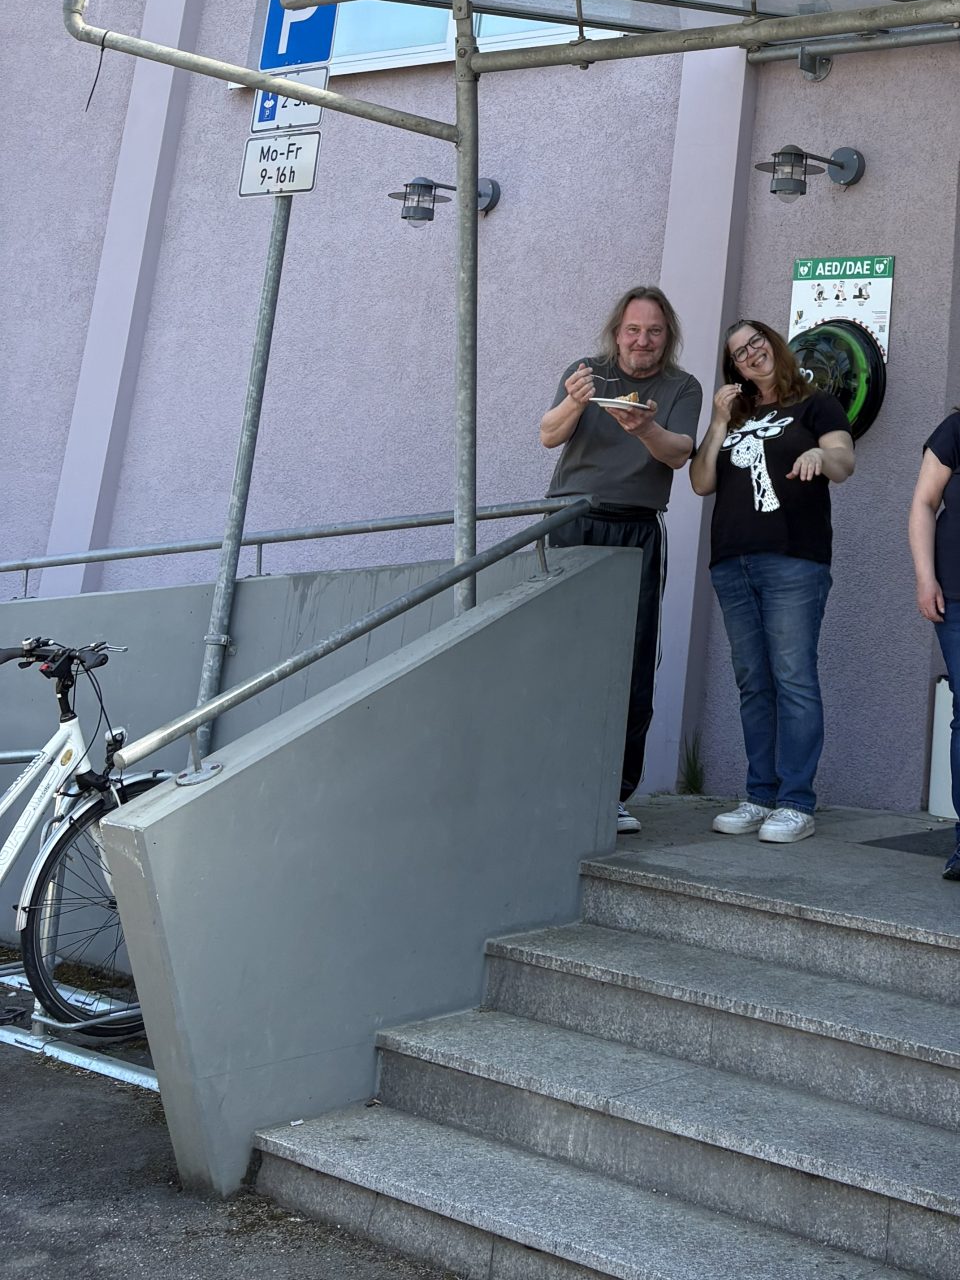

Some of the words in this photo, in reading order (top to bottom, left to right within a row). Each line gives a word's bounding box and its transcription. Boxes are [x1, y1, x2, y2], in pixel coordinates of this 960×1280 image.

[278, 6, 319, 55] P
[258, 143, 302, 163] Mo-Fr
[260, 166, 287, 186] 9-16
[288, 165, 296, 183] h
[815, 260, 872, 276] AED/DAE
